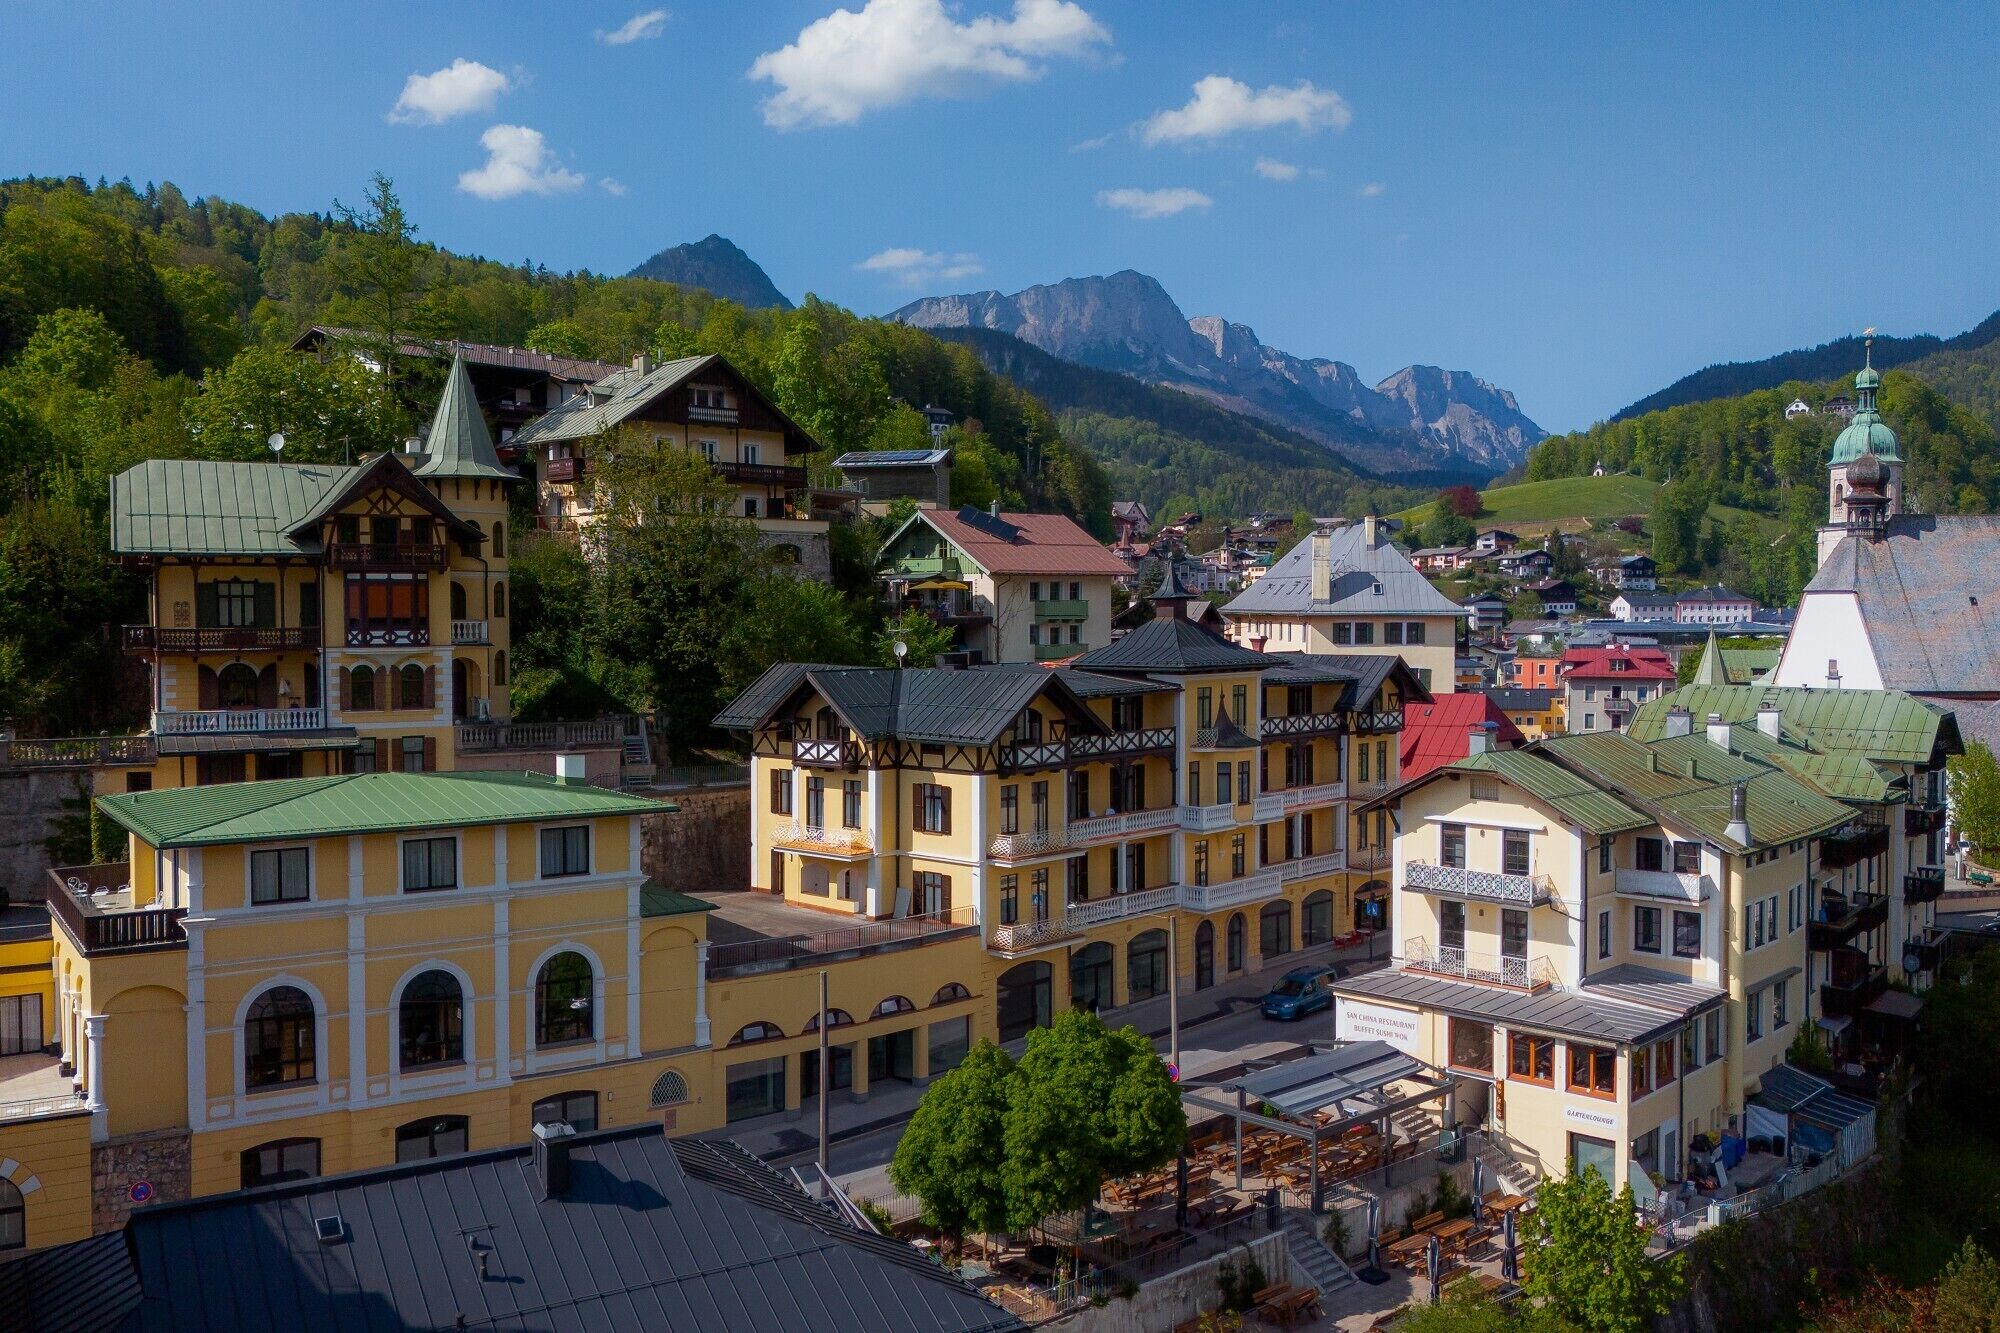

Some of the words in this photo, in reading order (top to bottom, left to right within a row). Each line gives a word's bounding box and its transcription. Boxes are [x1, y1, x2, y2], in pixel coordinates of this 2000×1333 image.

[1346, 1011, 1358, 1020] SAN
[1358, 1014, 1377, 1023] CHINA
[1378, 1017, 1416, 1031] RESTAURANT
[1354, 1024, 1375, 1034] BUFFET
[1376, 1028, 1394, 1038] SUSHI
[1394, 1032, 1408, 1041] WOK
[1566, 1109, 1614, 1125] GARTENLOUNGE
